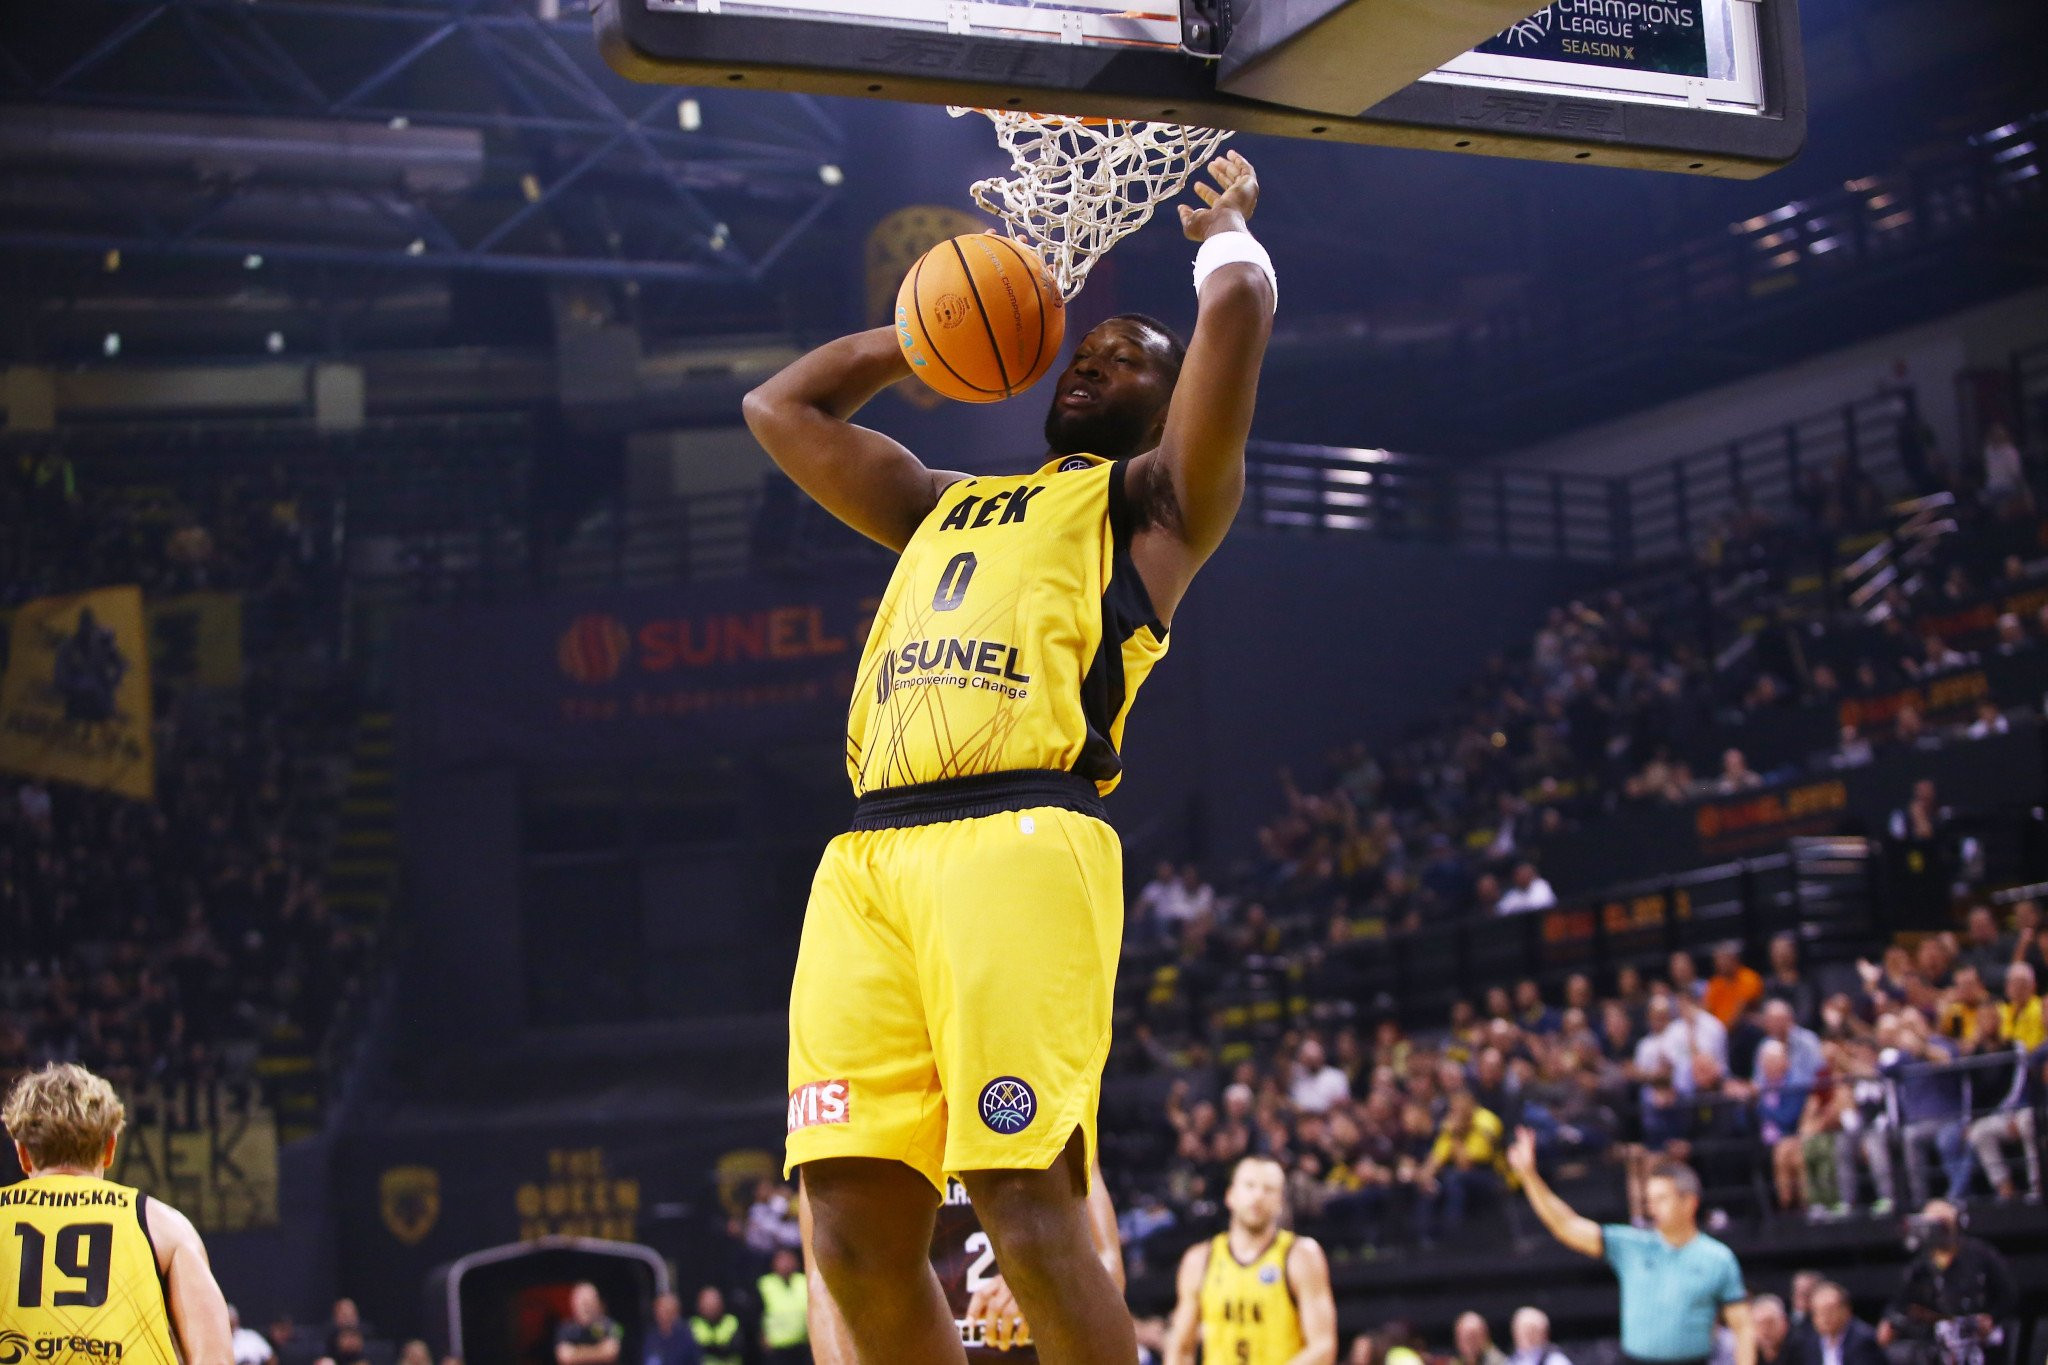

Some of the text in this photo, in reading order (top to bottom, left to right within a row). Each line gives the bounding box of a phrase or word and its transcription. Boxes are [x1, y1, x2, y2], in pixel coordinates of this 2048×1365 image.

[1558, 0, 1694, 27] CHAMPIONS
[1559, 15, 1634, 39] LEAGUE
[1562, 39, 1636, 60] SEASON X
[939, 485, 1046, 532] AEK
[931, 551, 978, 612] 0
[638, 604, 847, 673] SUNEL
[896, 638, 1031, 684] SUNEL
[894, 673, 1028, 700] Empowering Change
[0, 1188, 129, 1208] KUZMINSKAS
[14, 1221, 114, 1308] 19
[34, 1335, 123, 1360] green
